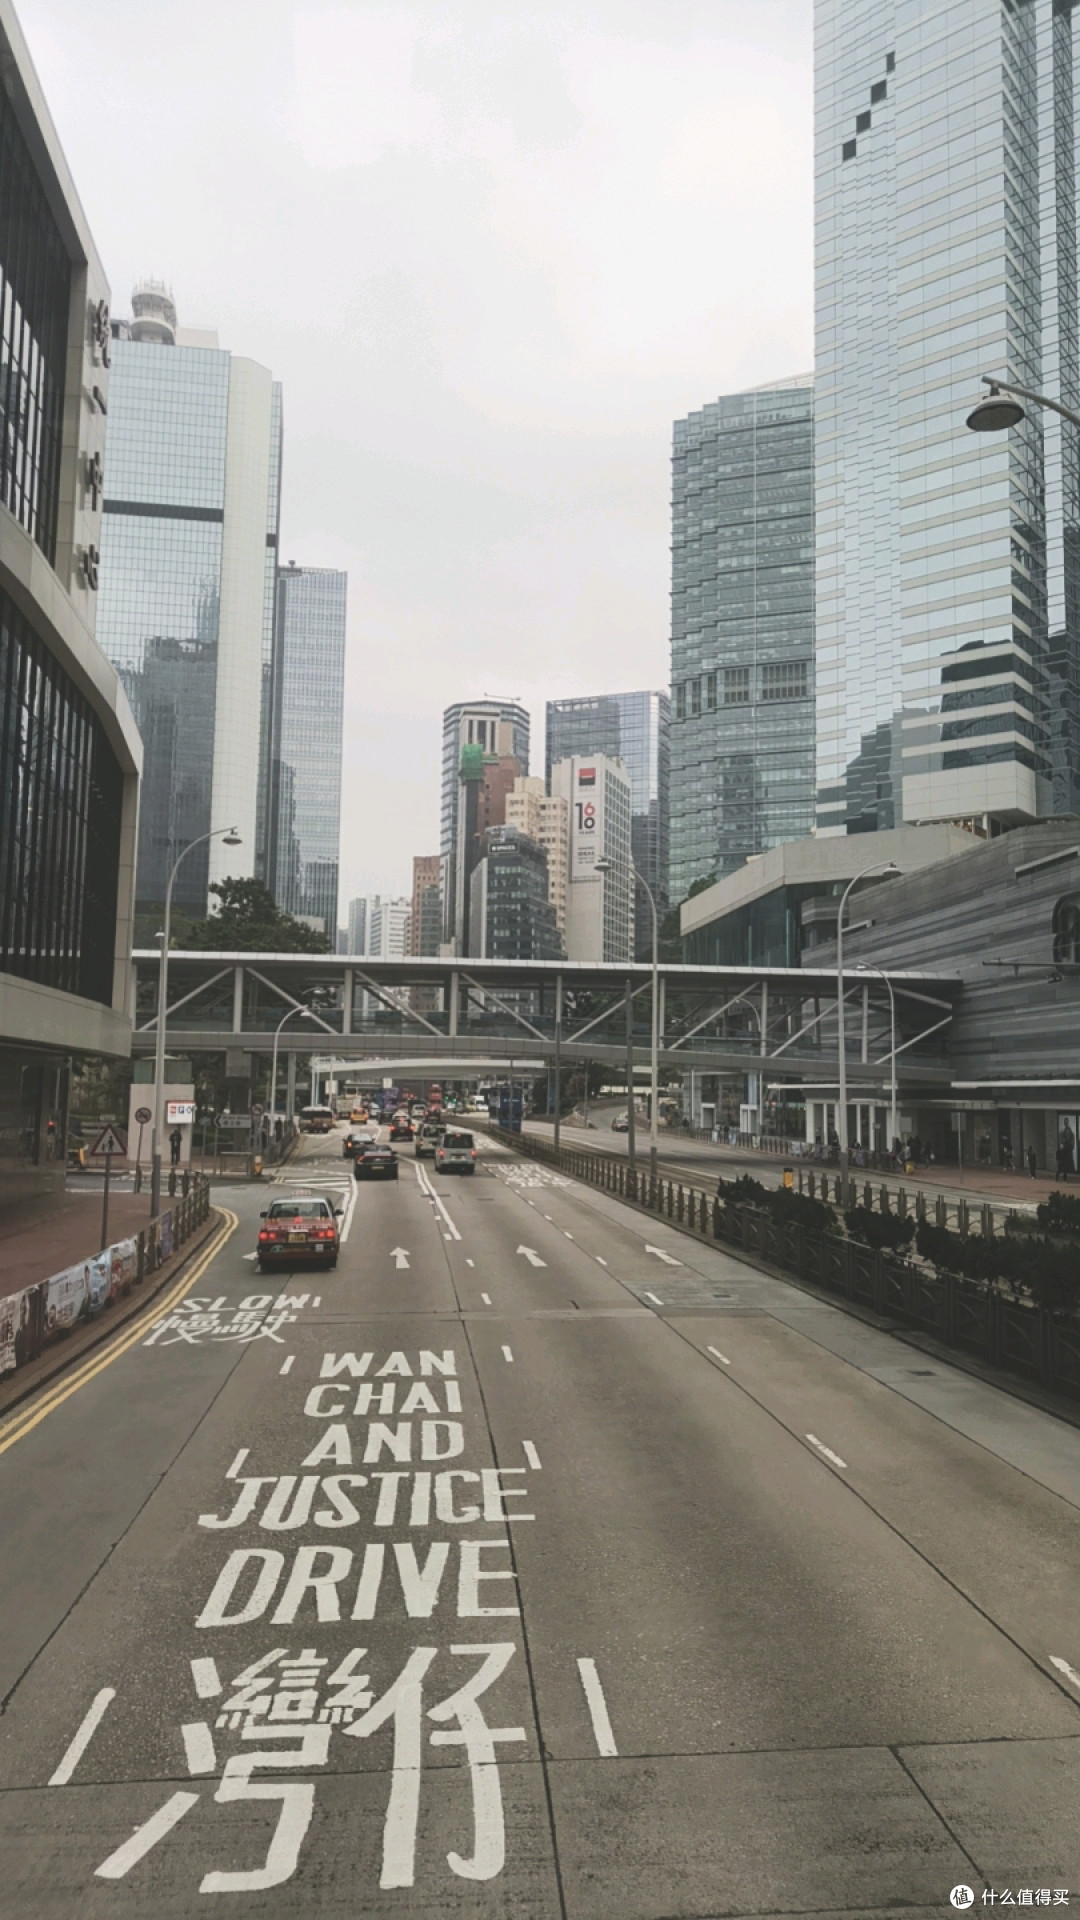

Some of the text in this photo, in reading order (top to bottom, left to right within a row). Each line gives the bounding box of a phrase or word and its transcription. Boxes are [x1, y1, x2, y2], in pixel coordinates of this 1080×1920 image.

[173, 1294, 311, 1313] SLOW
[142, 1310, 298, 1346] 慢駛
[319, 1350, 457, 1378] WAN
[303, 1381, 463, 1418] CHAI
[301, 1420, 465, 1466] AND
[197, 1468, 536, 1530] JUSTICE
[195, 1540, 521, 1628] DRIVE
[94, 1643, 527, 1893] 灣仔
